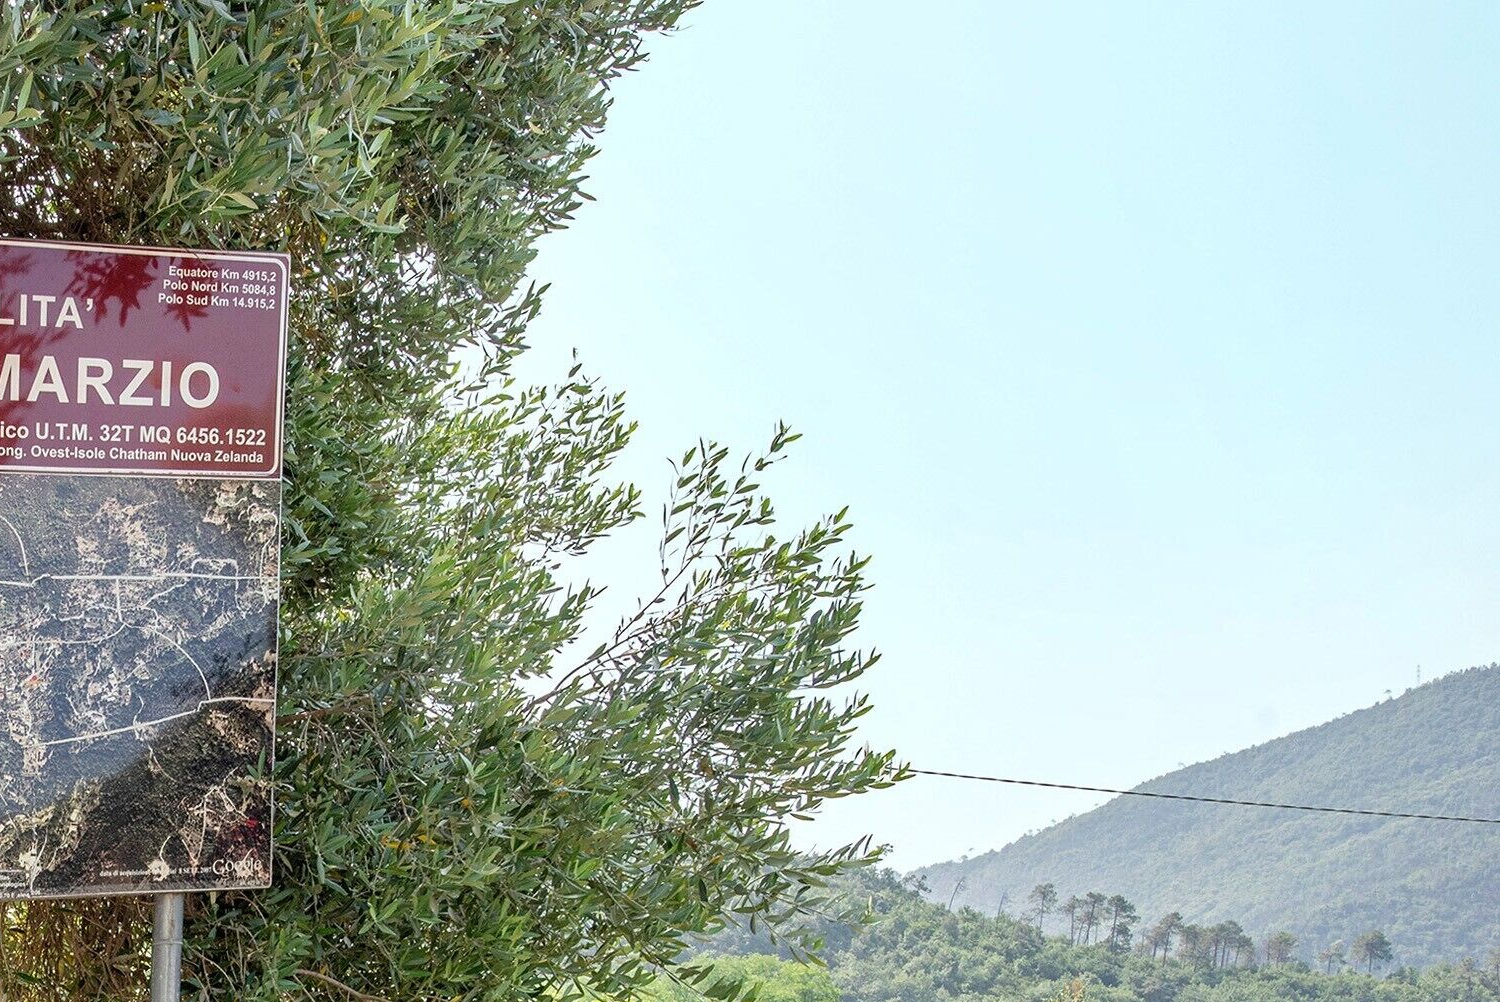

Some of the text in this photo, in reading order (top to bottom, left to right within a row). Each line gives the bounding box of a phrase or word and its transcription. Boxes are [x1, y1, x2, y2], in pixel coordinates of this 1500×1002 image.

[168, 266, 277, 283] Equatore Km 4915,2
[163, 279, 276, 296] Polo Nord Km 5084,8
[158, 292, 275, 309] Polo Sud Km 14.915,2
[35, 422, 93, 441] U.T.M.
[99, 425, 134, 443] 32T
[139, 425, 171, 445] MQ
[176, 427, 266, 446] 6456.1522
[30, 444, 106, 460] Ovest-Isole
[109, 446, 168, 461] Chatham
[170, 448, 211, 463] Nuova
[214, 450, 264, 464] Zelanda
